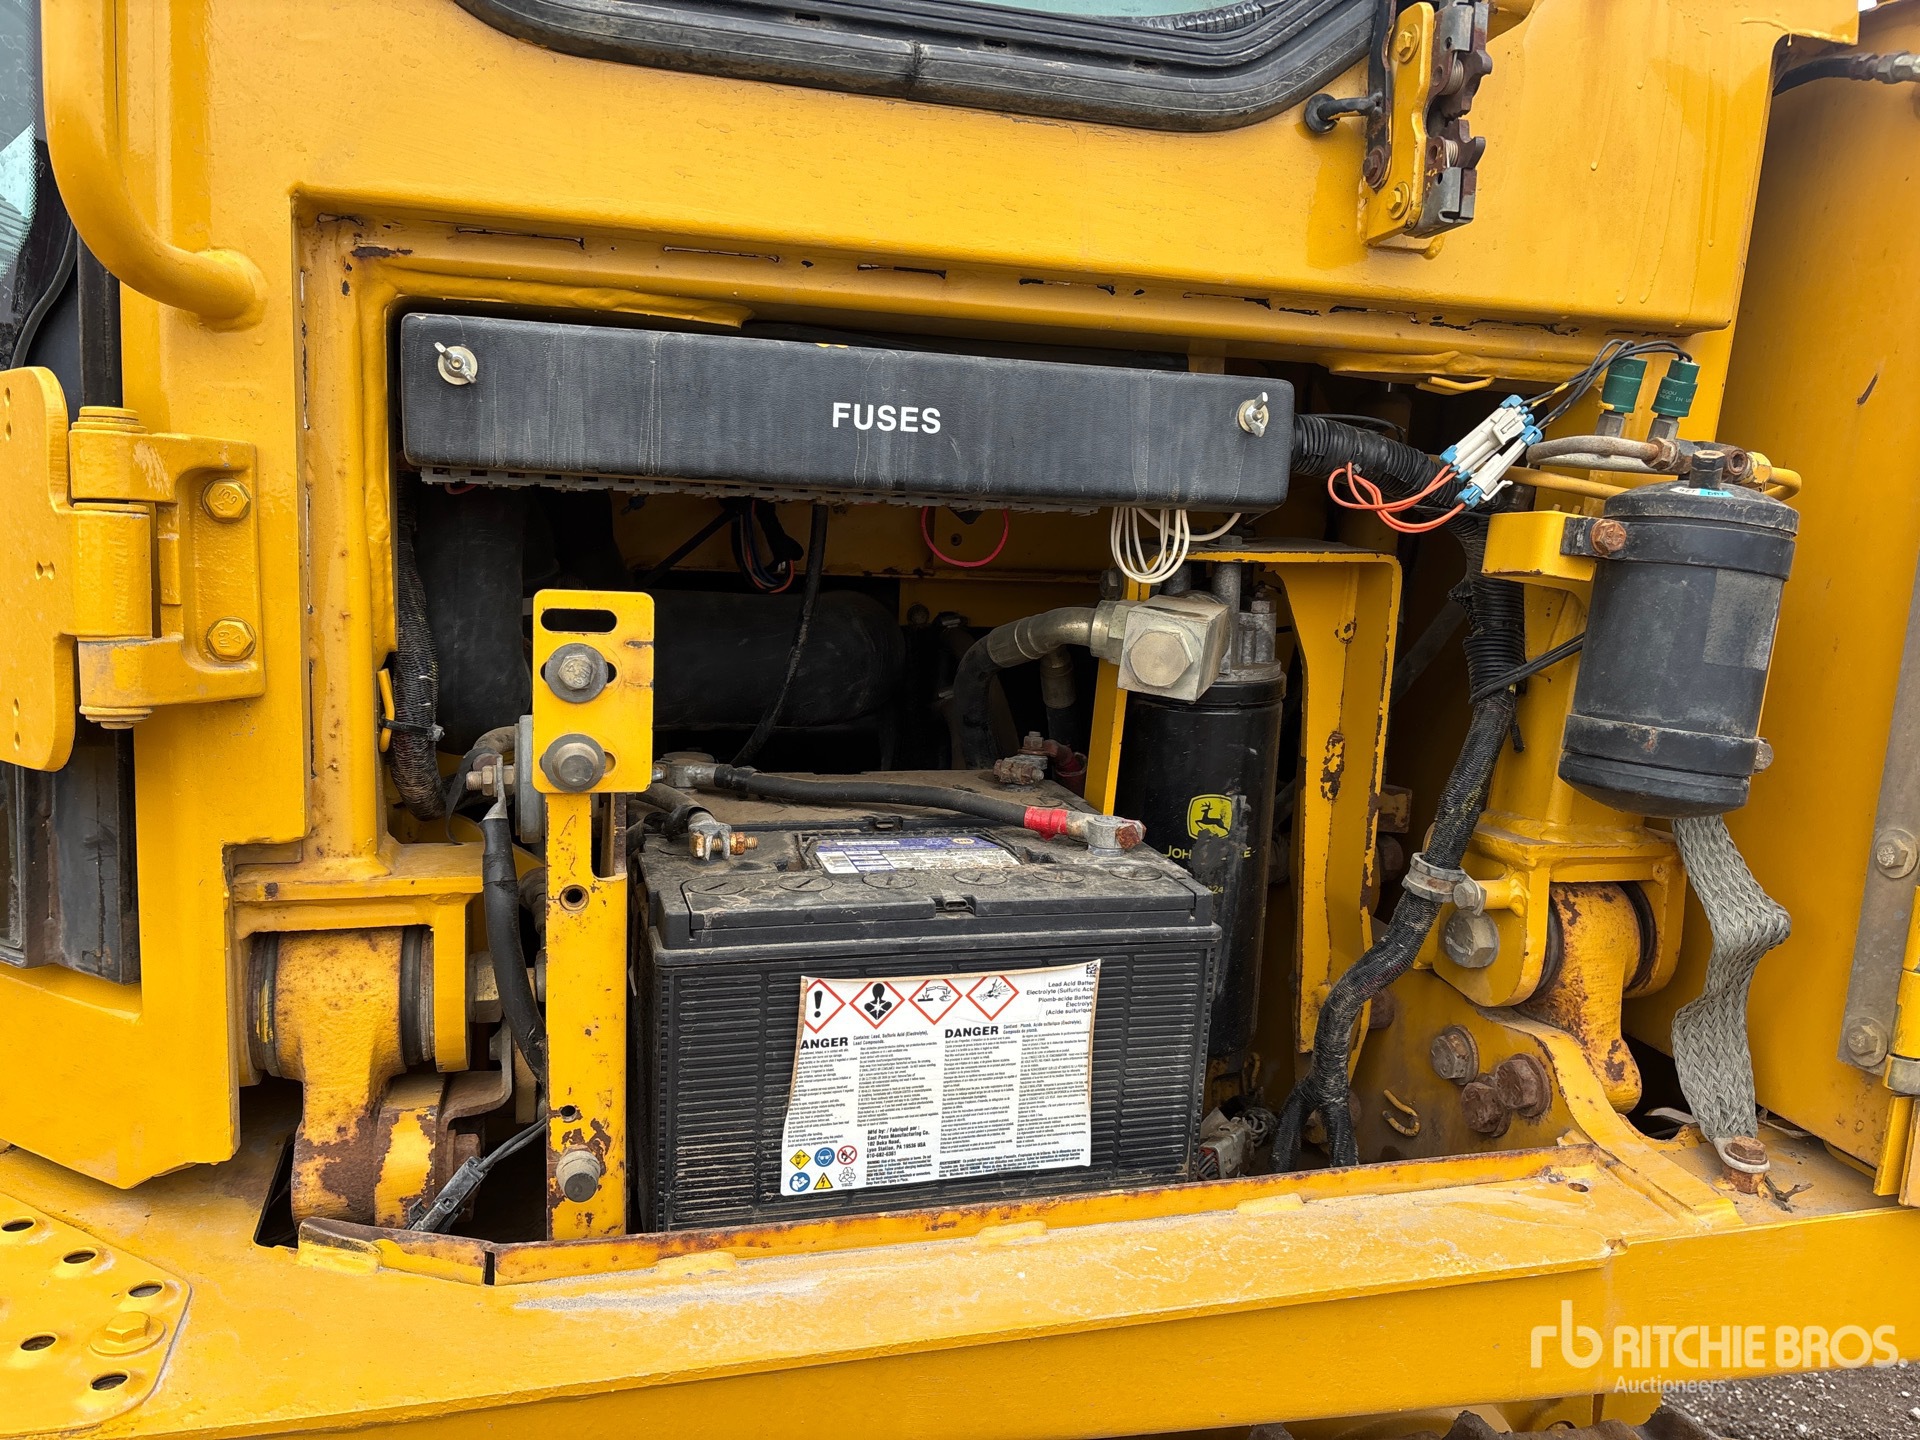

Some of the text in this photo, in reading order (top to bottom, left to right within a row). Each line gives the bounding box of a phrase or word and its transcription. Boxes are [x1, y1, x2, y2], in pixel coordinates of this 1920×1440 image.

[832, 402, 941, 434] FUSES
[1163, 845, 1193, 860] JOH
[944, 1025, 999, 1039] DANGER
